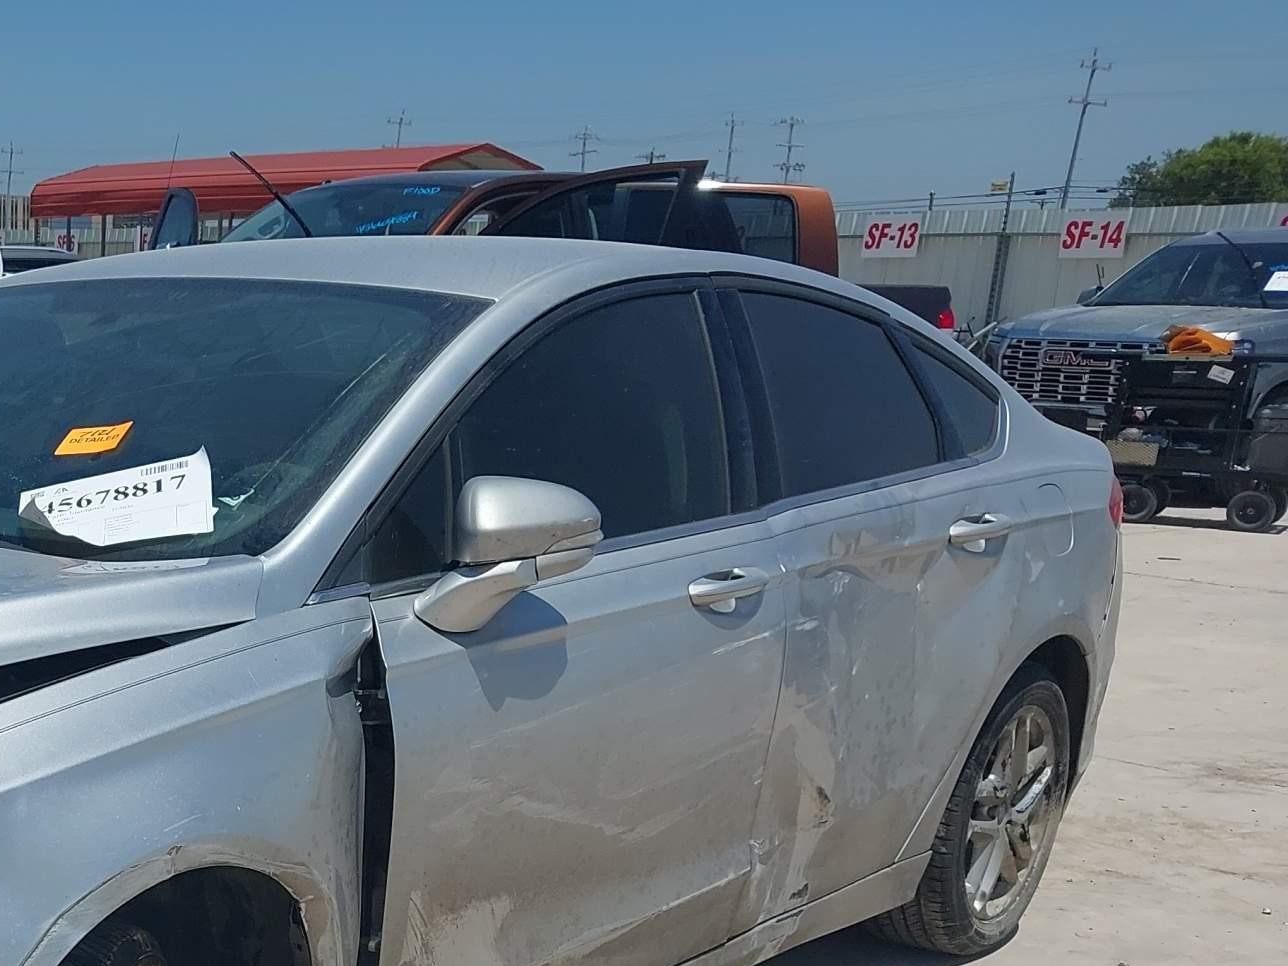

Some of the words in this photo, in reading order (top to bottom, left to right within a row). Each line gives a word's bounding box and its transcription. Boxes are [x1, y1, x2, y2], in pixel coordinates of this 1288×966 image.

[864, 222, 919, 249] SF-13
[1062, 221, 1125, 249] SF-14
[68, 433, 120, 444] DETAILED
[41, 474, 187, 515] 45678817
